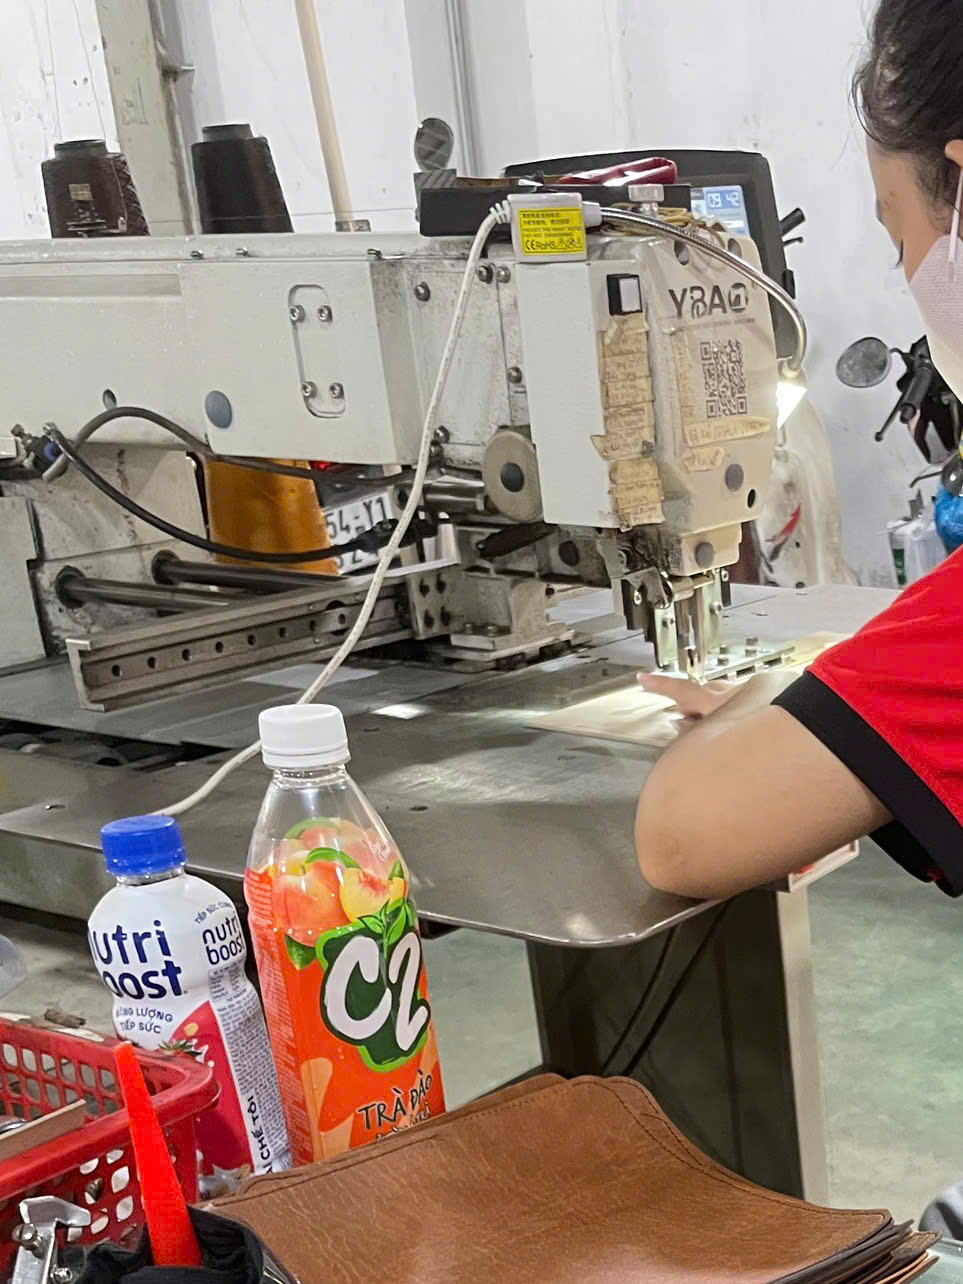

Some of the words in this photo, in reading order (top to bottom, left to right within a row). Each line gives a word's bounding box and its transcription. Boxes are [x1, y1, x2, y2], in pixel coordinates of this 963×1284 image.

[89, 919, 172, 966] utri
[102, 959, 183, 1000] oost
[324, 934, 429, 1052] C2
[136, 1007, 174, 1023] LƯỢNG
[138, 1020, 162, 1034] SỨC
[358, 1087, 408, 1130] TRÀ
[410, 1068, 433, 1110] ĐÀO
